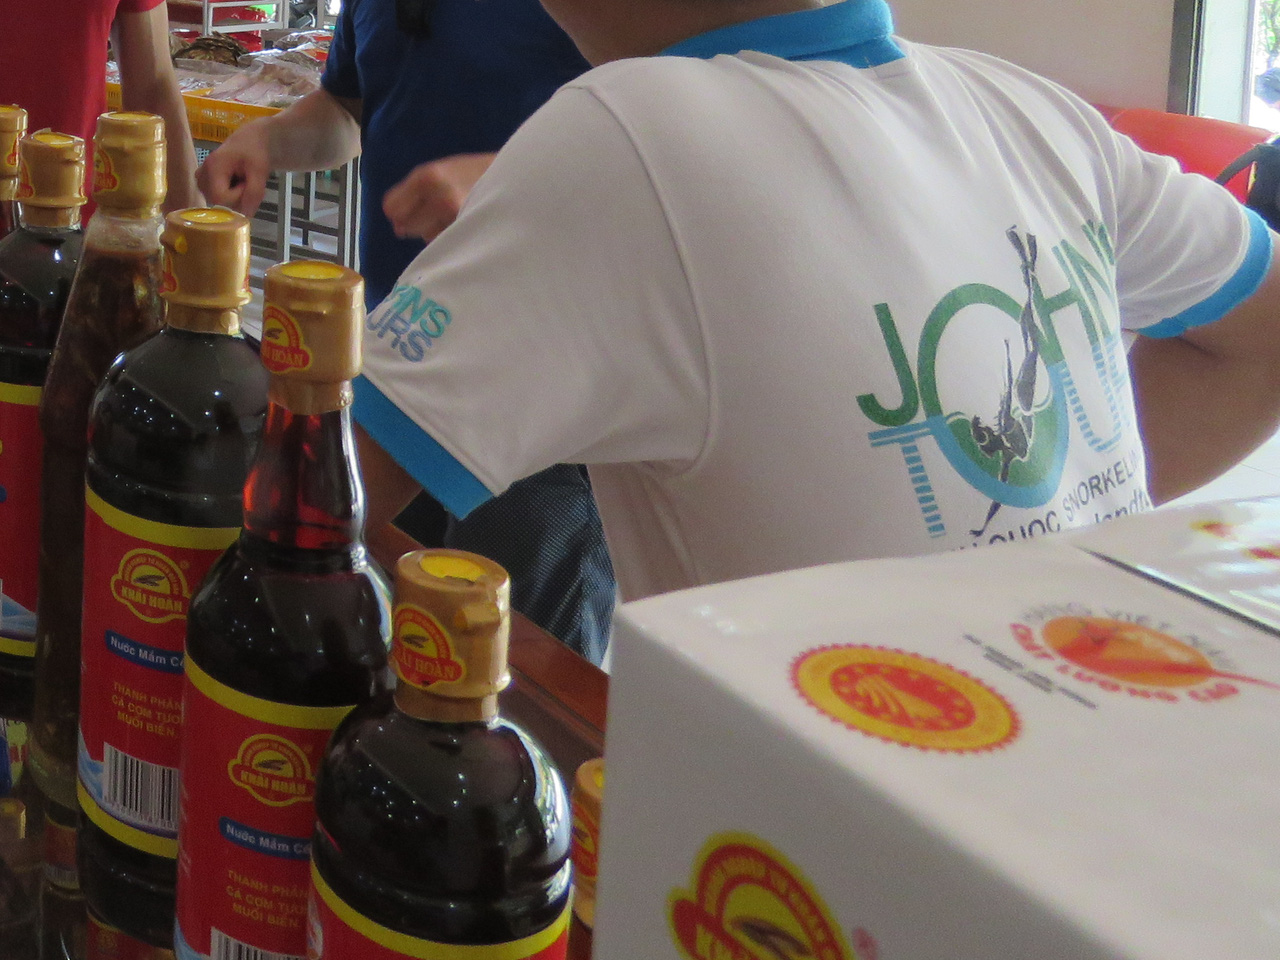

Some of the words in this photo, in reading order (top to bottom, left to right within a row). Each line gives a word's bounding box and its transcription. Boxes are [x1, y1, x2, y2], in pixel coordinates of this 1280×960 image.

[121, 586, 147, 605] KHẢI
[149, 593, 183, 612] HOÀN
[110, 635, 136, 656] Nước
[138, 648, 167, 665] Mắm
[226, 823, 255, 844] Nước
